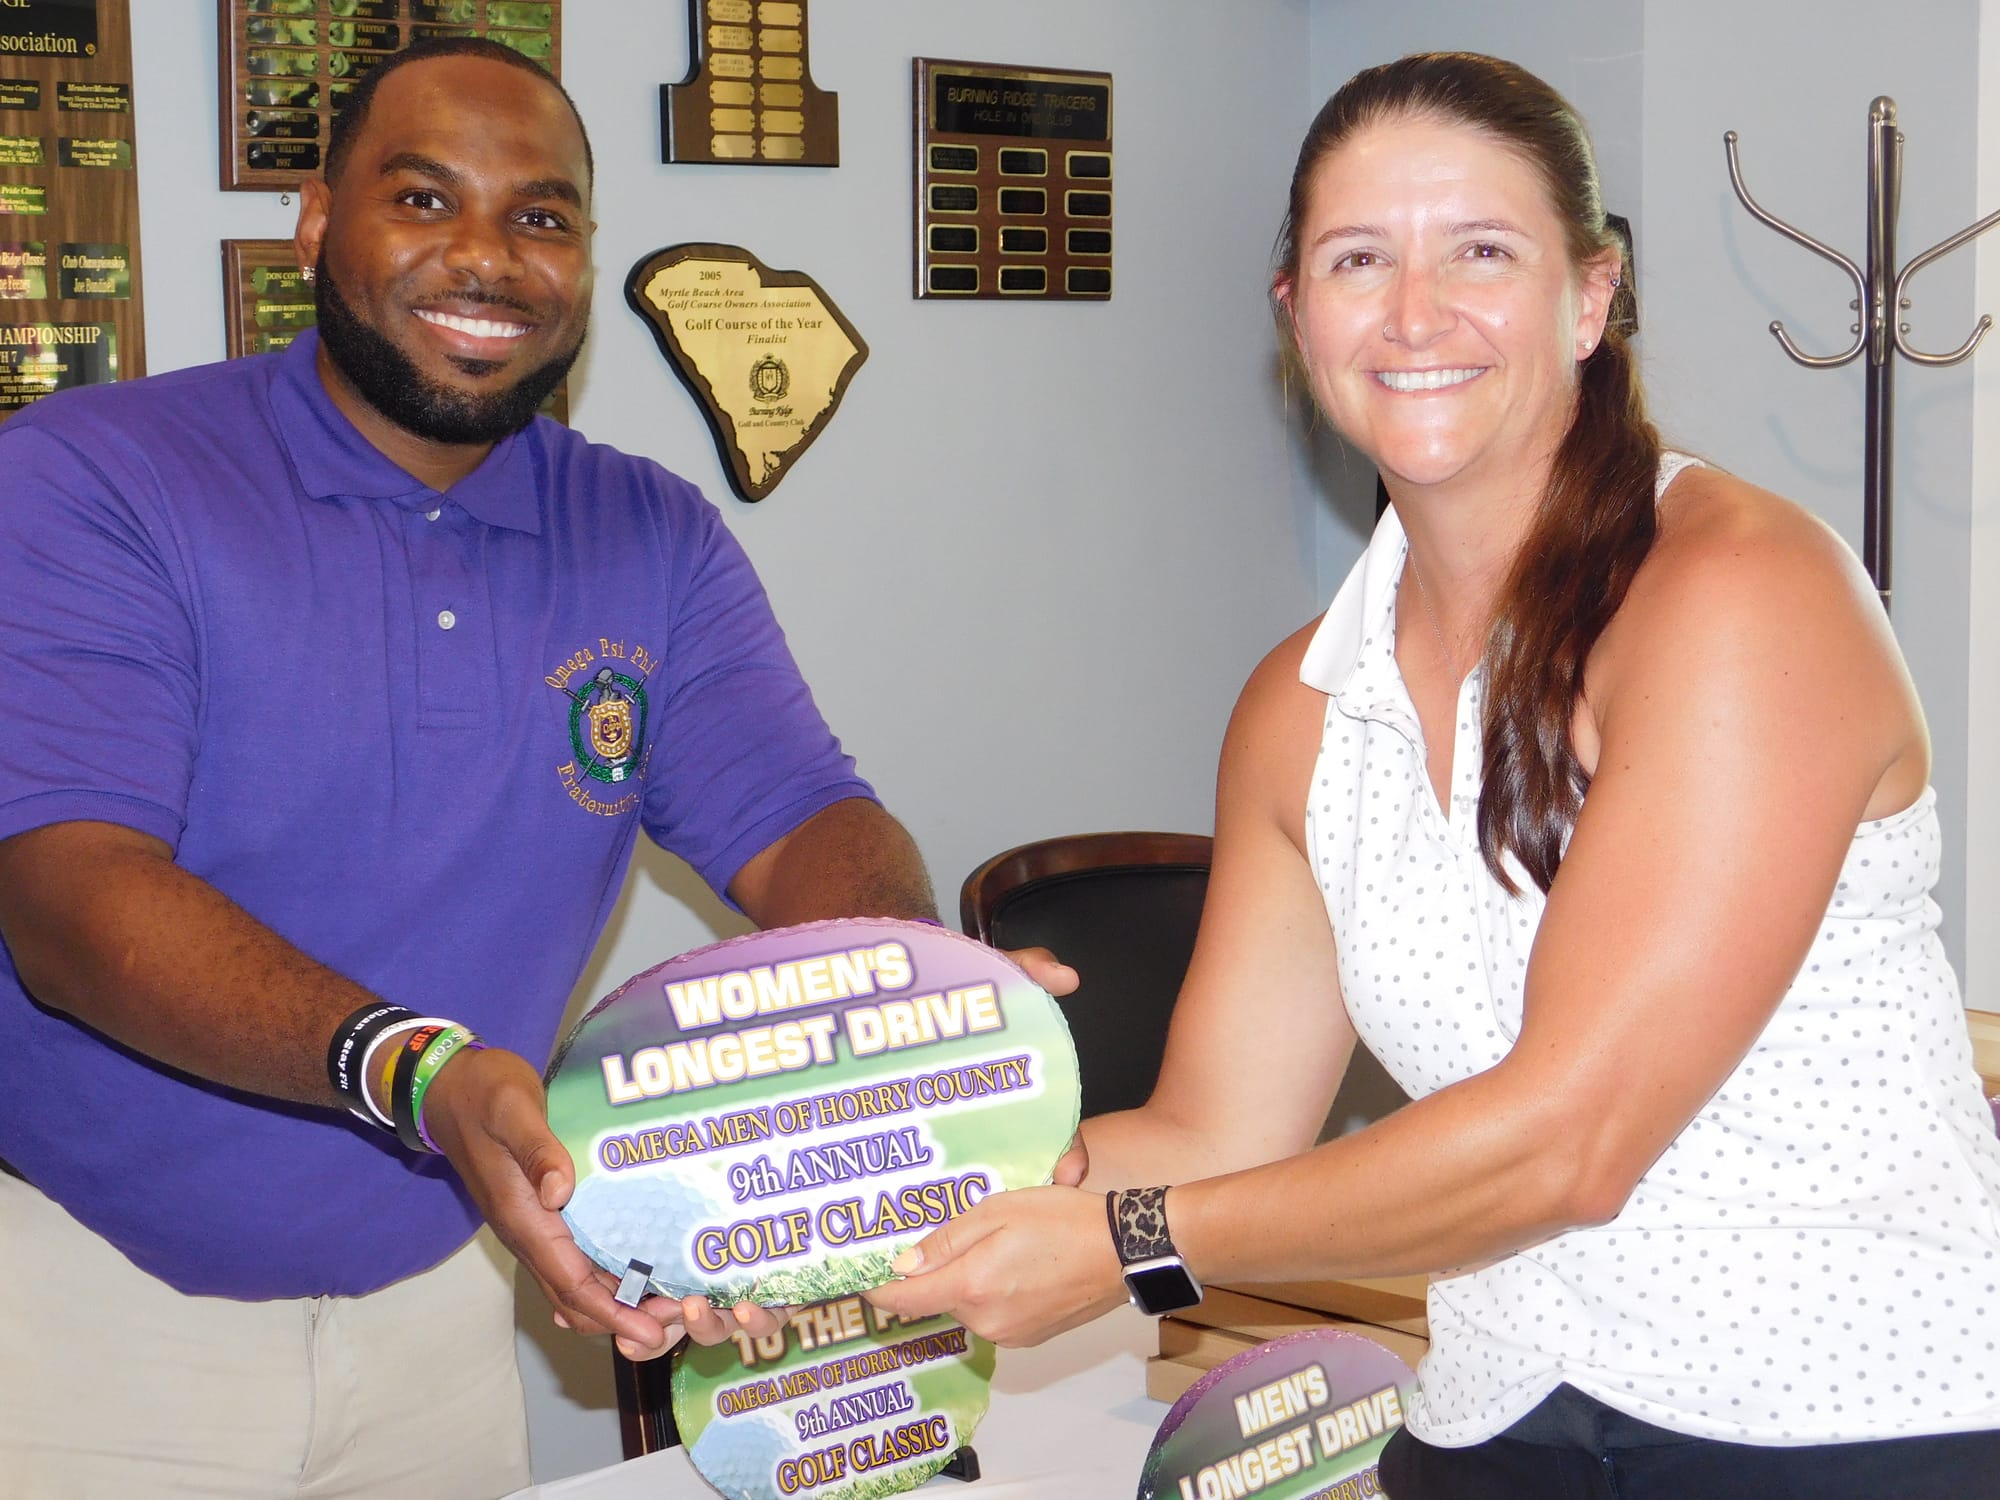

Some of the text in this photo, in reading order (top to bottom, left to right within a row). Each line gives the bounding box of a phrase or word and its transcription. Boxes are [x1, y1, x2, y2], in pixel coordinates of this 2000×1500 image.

[0, 31, 78, 53] sociation
[948, 87, 998, 104] BURNING
[1003, 91, 1037, 107] RIDGE
[974, 109, 1000, 121] HOLE
[659, 288, 744, 299] Myrtle Beach Area
[699, 271, 722, 280] 2005
[667, 299, 811, 310] Golf Course Owners Association
[685, 317, 823, 331] Golf Course of the Year
[747, 334, 787, 344] Finalist
[765, 420, 789, 428] Country
[790, 418, 804, 426] Club
[544, 637, 660, 689] Omega Psi Phi
[557, 760, 640, 816] Fraternit
[667, 944, 912, 1030] WOMEN'S
[337, 1038, 354, 1071] Stay
[425, 1031, 464, 1066] S.COM
[602, 984, 1003, 1103] LONGEST DRIVE
[601, 1057, 1032, 1169] OMEGA MEN OF HORRY COUNTY
[731, 1130, 929, 1201] 9th ANNUAL
[695, 1176, 987, 1271] GOLF CLASSIC
[791, 1297, 867, 1350] THE
[719, 1328, 967, 1415] OMEGA MEN OF HORRY COUNTY
[798, 1384, 912, 1439] 9th ANNUAL
[1234, 1364, 1329, 1439] MEN'S
[779, 1419, 948, 1493] GOLF CLASSIC
[1178, 1385, 1404, 1500] LONGEST DRIVE
